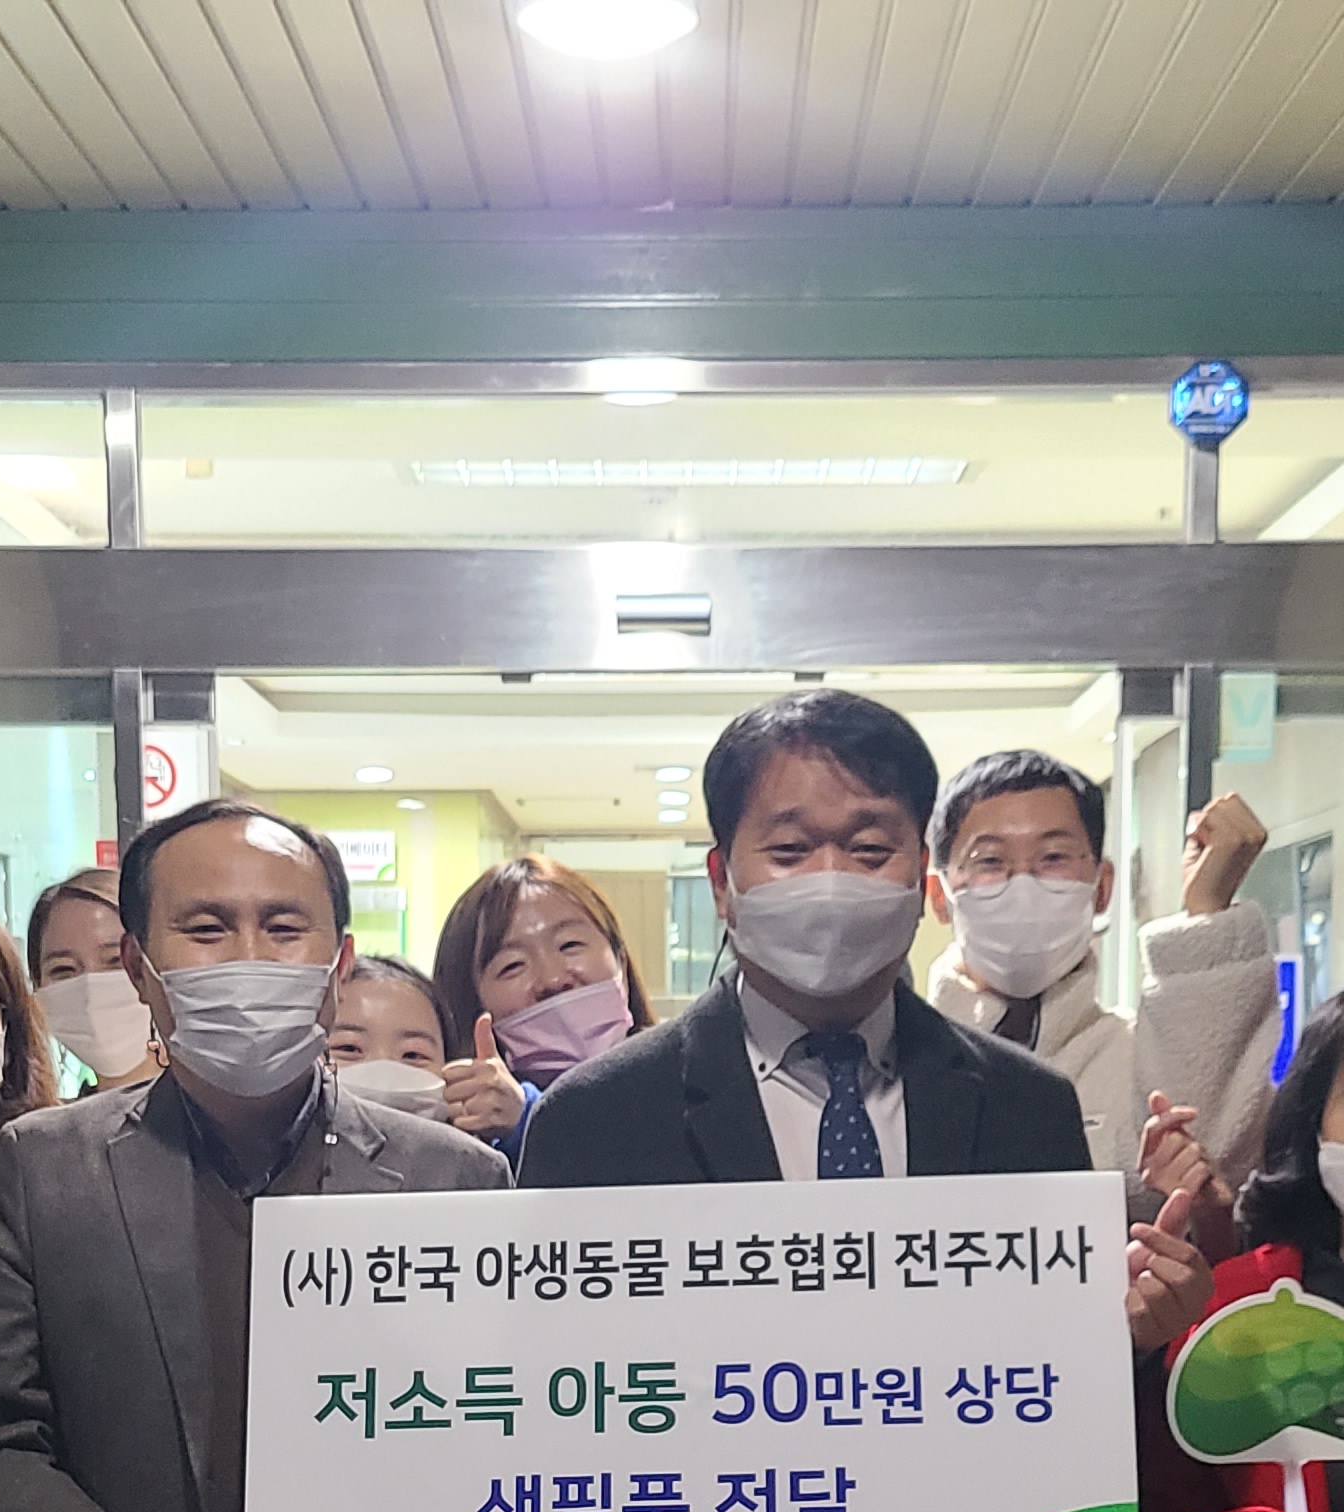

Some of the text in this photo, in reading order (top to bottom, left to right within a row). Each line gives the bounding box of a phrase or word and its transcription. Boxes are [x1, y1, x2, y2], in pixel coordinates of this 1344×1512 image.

[283, 1226, 1092, 1307] (사) 한국 야생동물 보호협회 전주지사
[315, 1362, 1059, 1438] 저소득 아동 50만원 상당
